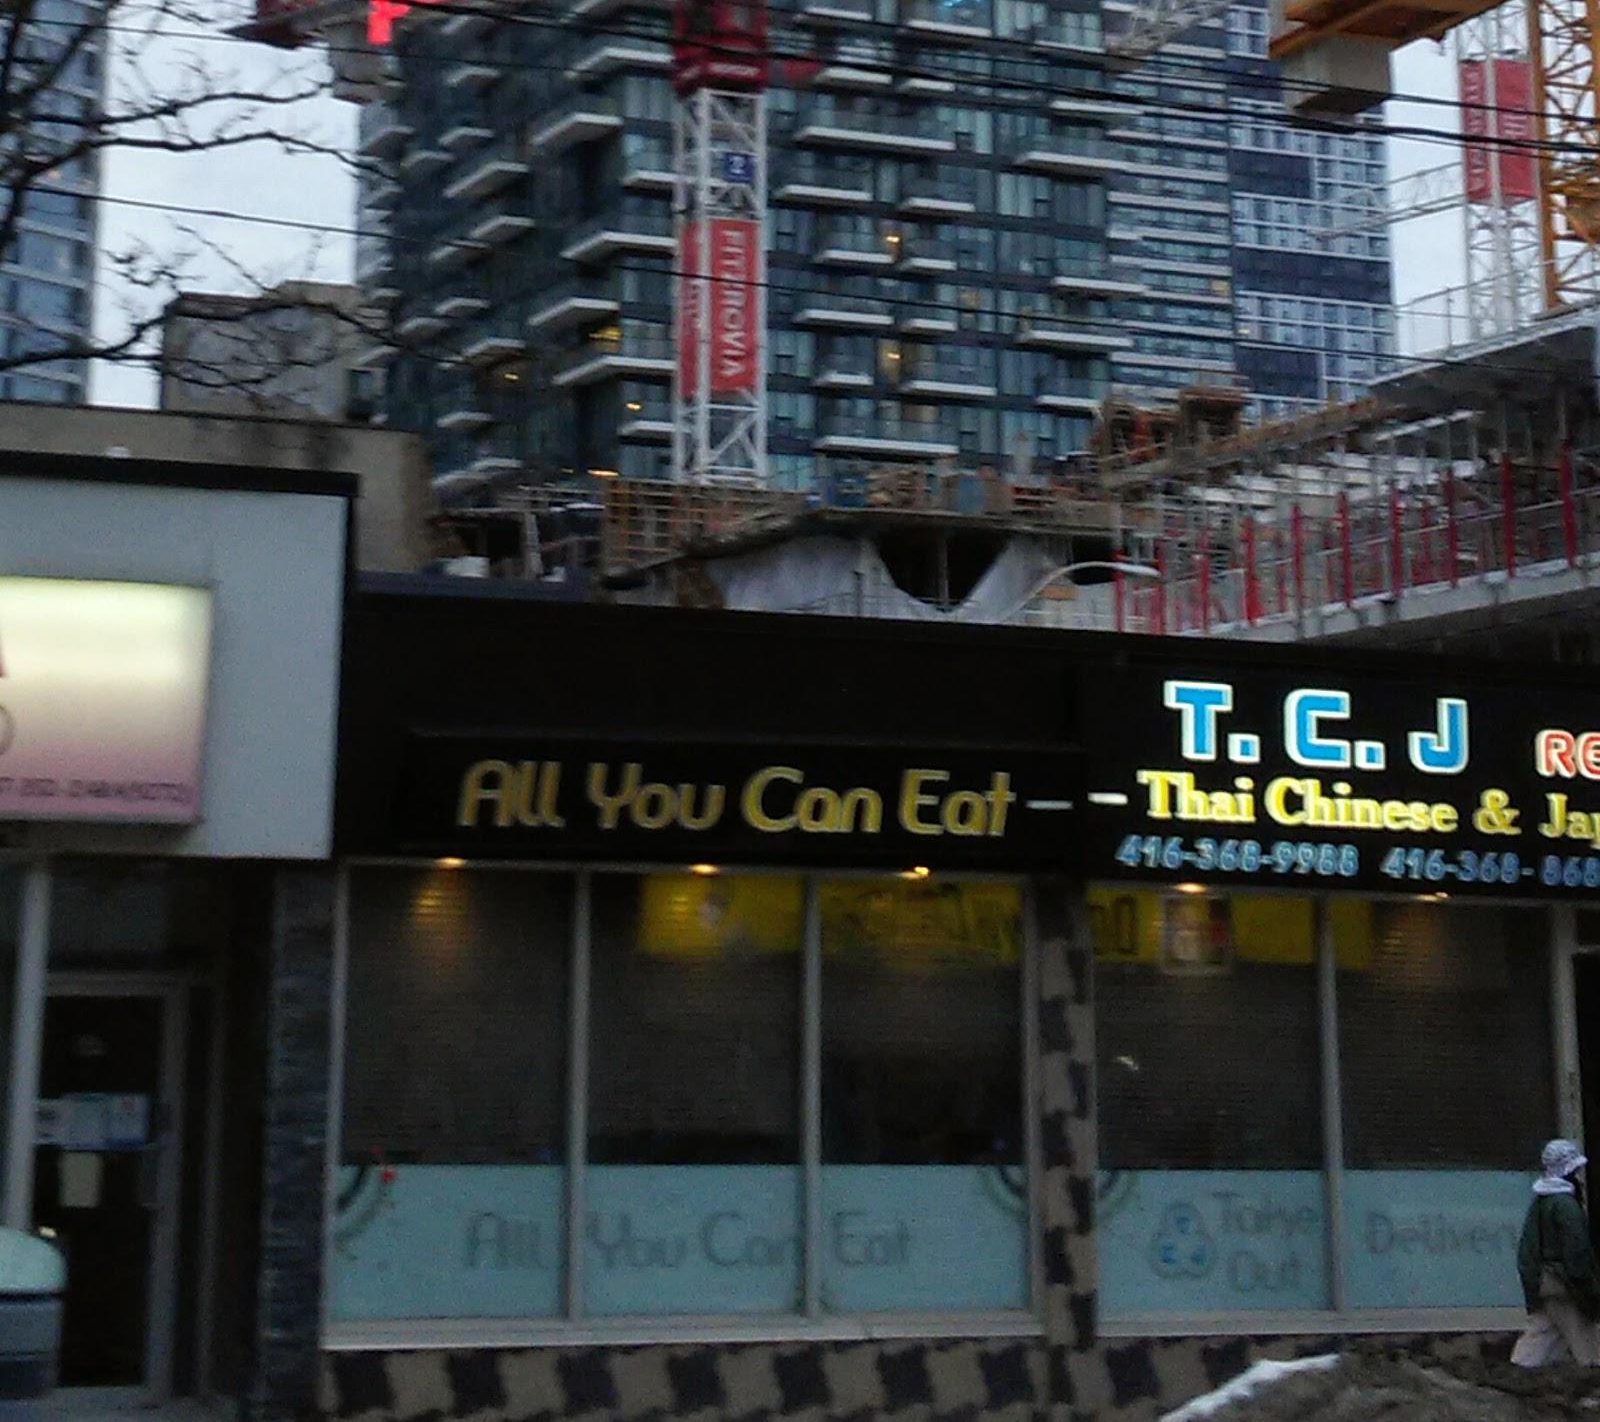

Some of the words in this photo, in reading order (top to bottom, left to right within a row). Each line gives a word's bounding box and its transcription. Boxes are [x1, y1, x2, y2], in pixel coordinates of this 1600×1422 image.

[457, 759, 566, 827] All
[586, 762, 726, 829] You
[740, 765, 884, 833] Can
[898, 768, 1017, 836] Eat
[1136, 769, 1256, 823] Thai
[1265, 776, 1460, 832] Chinese
[1472, 788, 1523, 835] &
[1115, 834, 1360, 876] 416-368-9988
[464, 1211, 549, 1270] All
[584, 1210, 689, 1270] You
[825, 1209, 911, 1269] Eat
